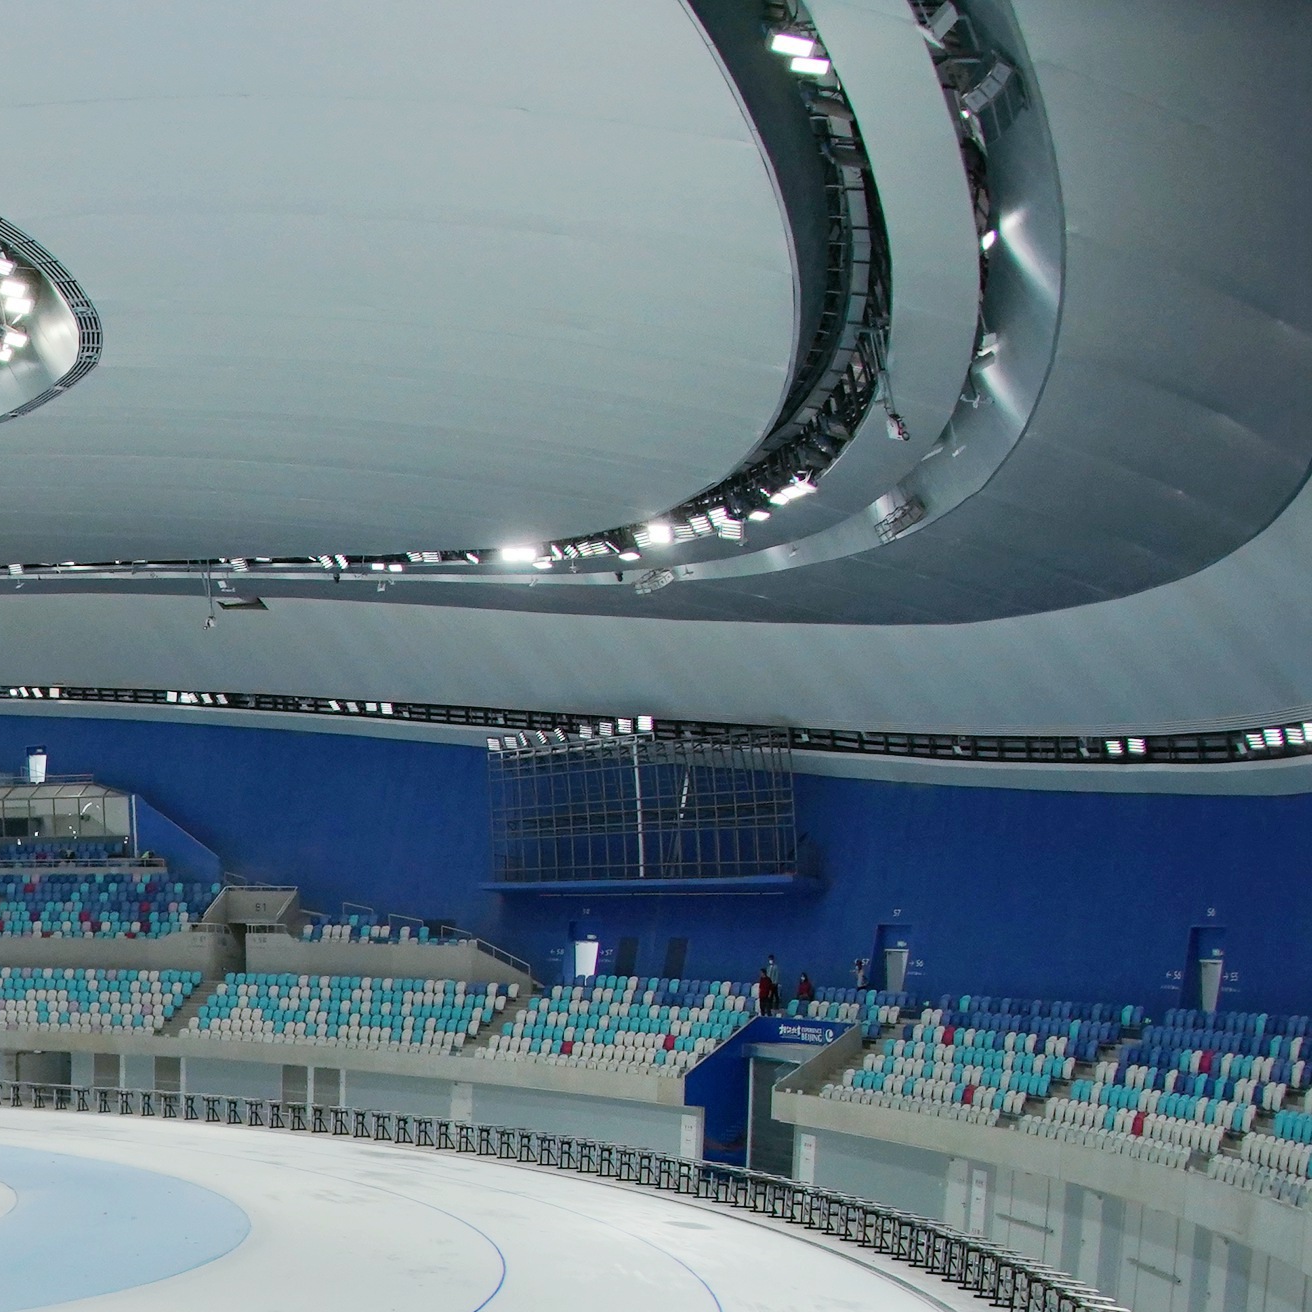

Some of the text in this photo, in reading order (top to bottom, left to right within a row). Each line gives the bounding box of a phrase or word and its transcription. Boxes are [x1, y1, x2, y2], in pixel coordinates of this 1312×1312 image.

[892, 908, 902, 917] S7
[1207, 907, 1216, 917] S6
[801, 1033, 823, 1043] BEIJING
